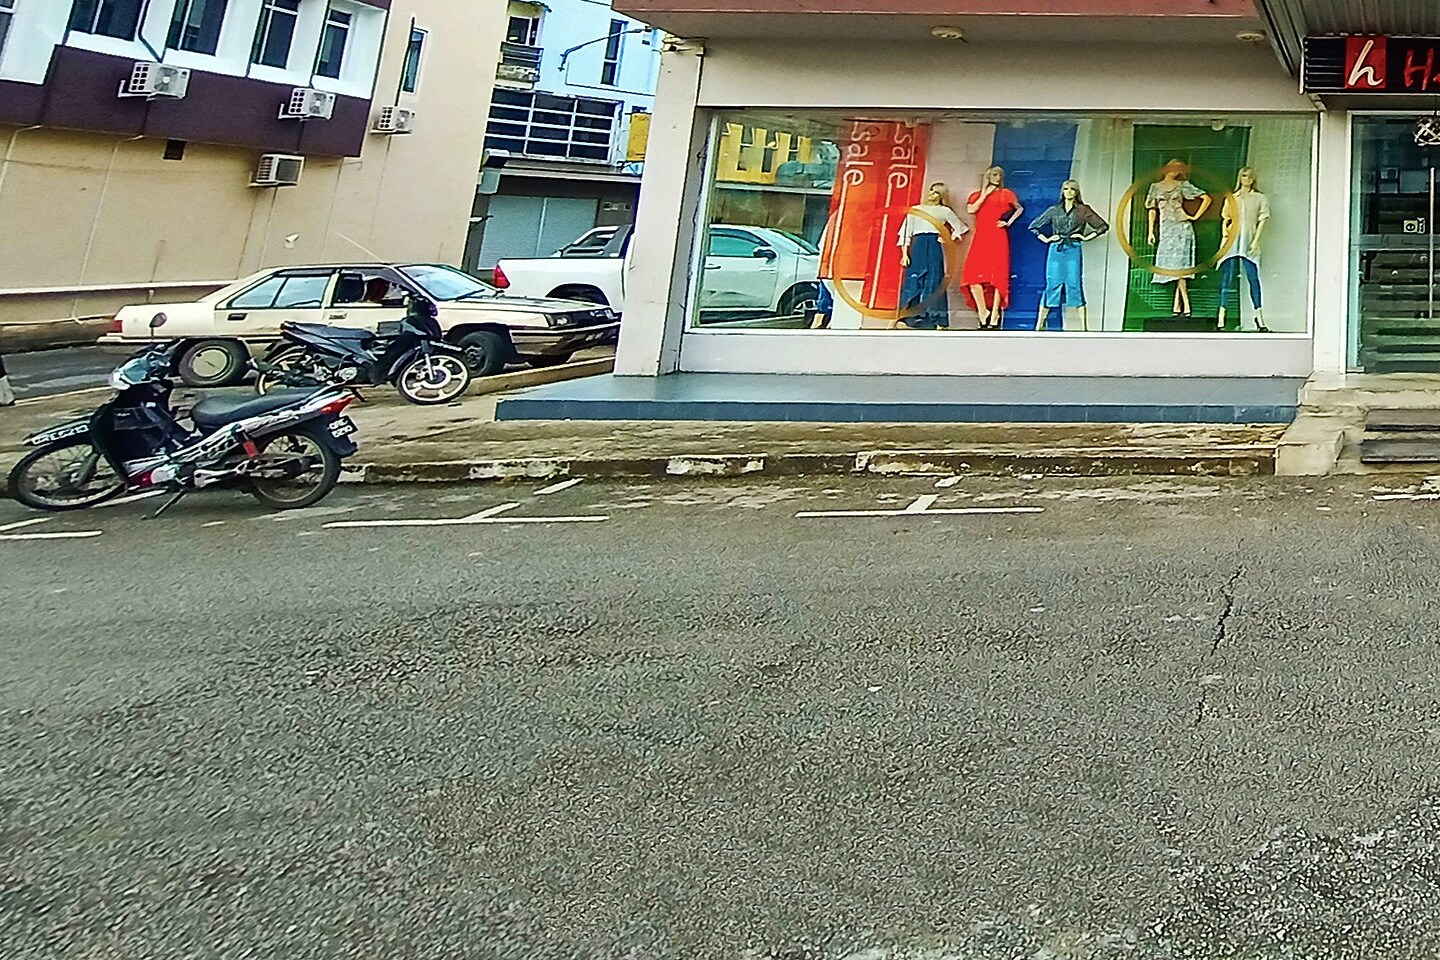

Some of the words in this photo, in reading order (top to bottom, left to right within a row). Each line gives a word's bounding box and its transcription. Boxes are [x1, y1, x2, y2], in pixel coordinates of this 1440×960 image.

[1348, 39, 1385, 88] h
[843, 122, 874, 186] sale
[888, 124, 918, 189] sale
